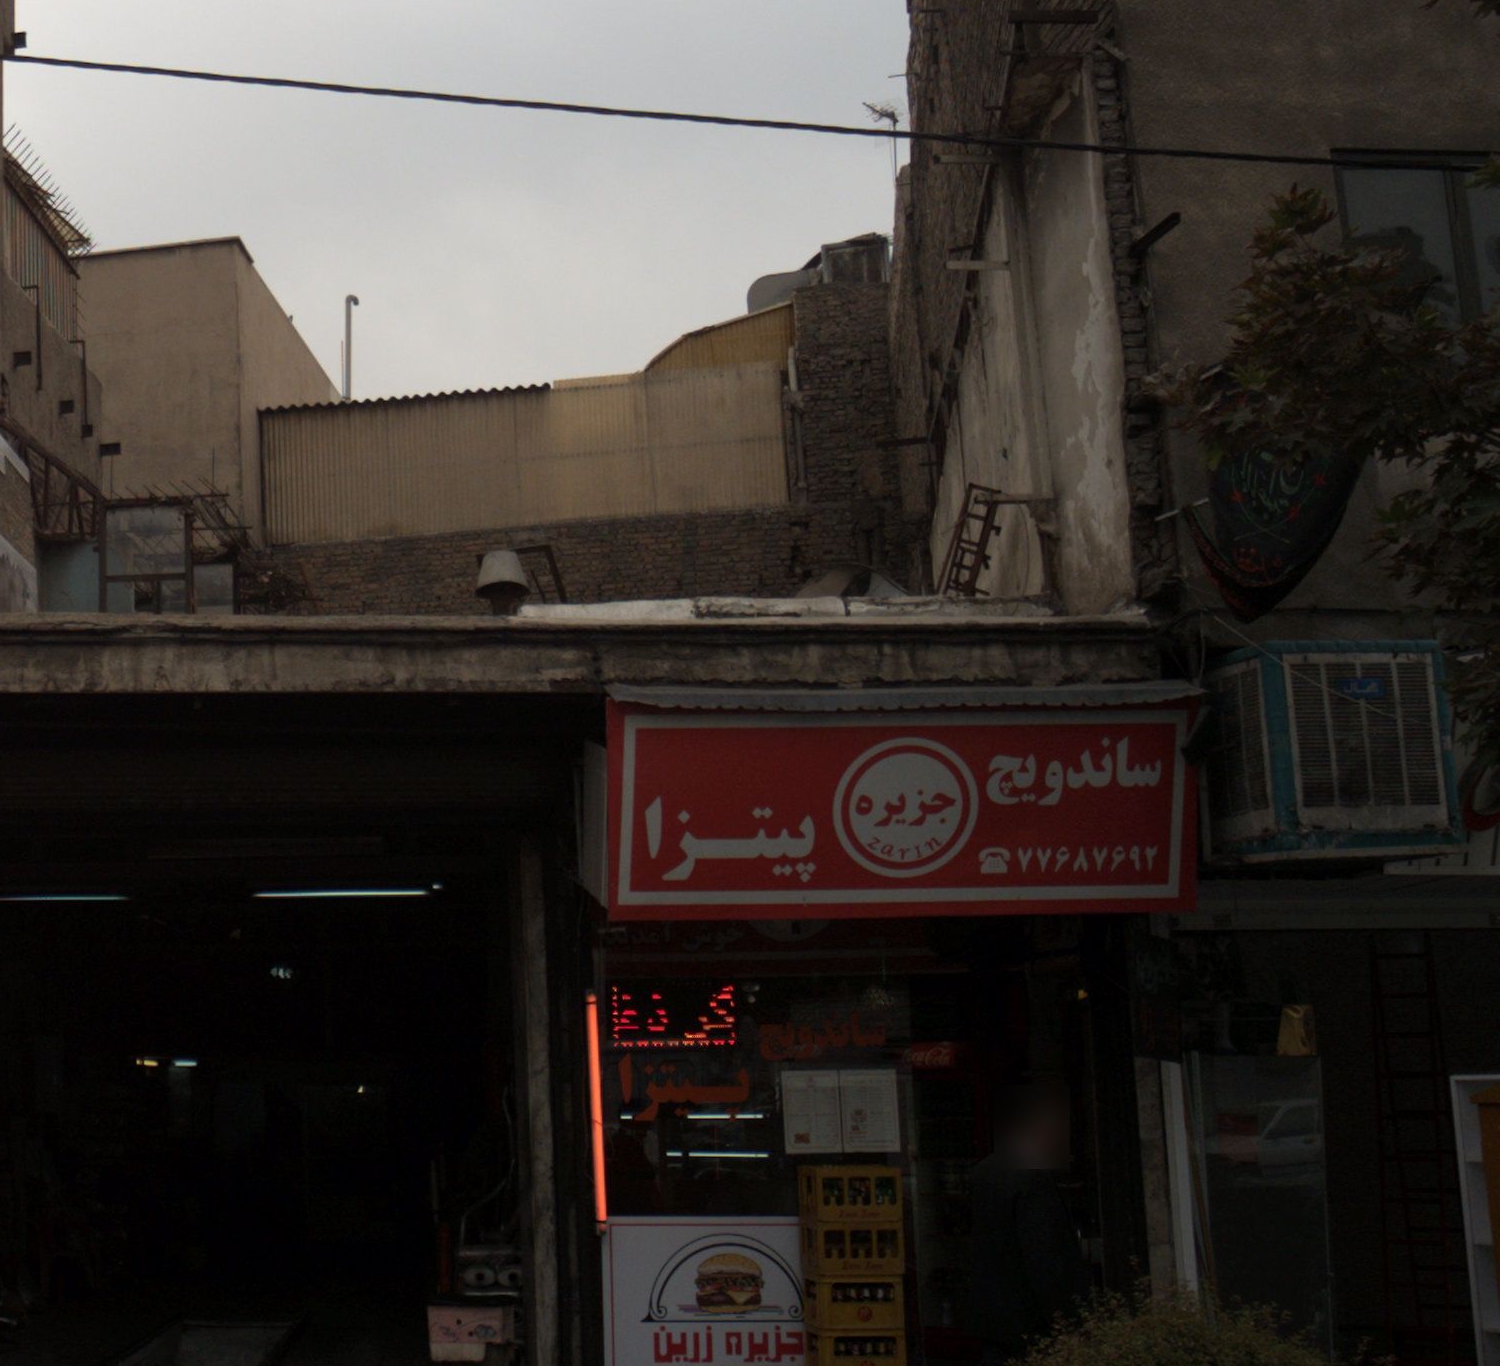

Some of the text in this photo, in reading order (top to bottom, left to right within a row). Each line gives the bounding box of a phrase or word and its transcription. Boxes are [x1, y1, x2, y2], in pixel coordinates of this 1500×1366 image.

[986, 735, 1162, 806] ساندویچ
[855, 789, 956, 827] جزیره
[644, 794, 817, 883] پیتزا
[1017, 845, 1158, 873] ۷۷۶۸۷۶۹۲
[653, 1325, 804, 1363] جزیره زرین
